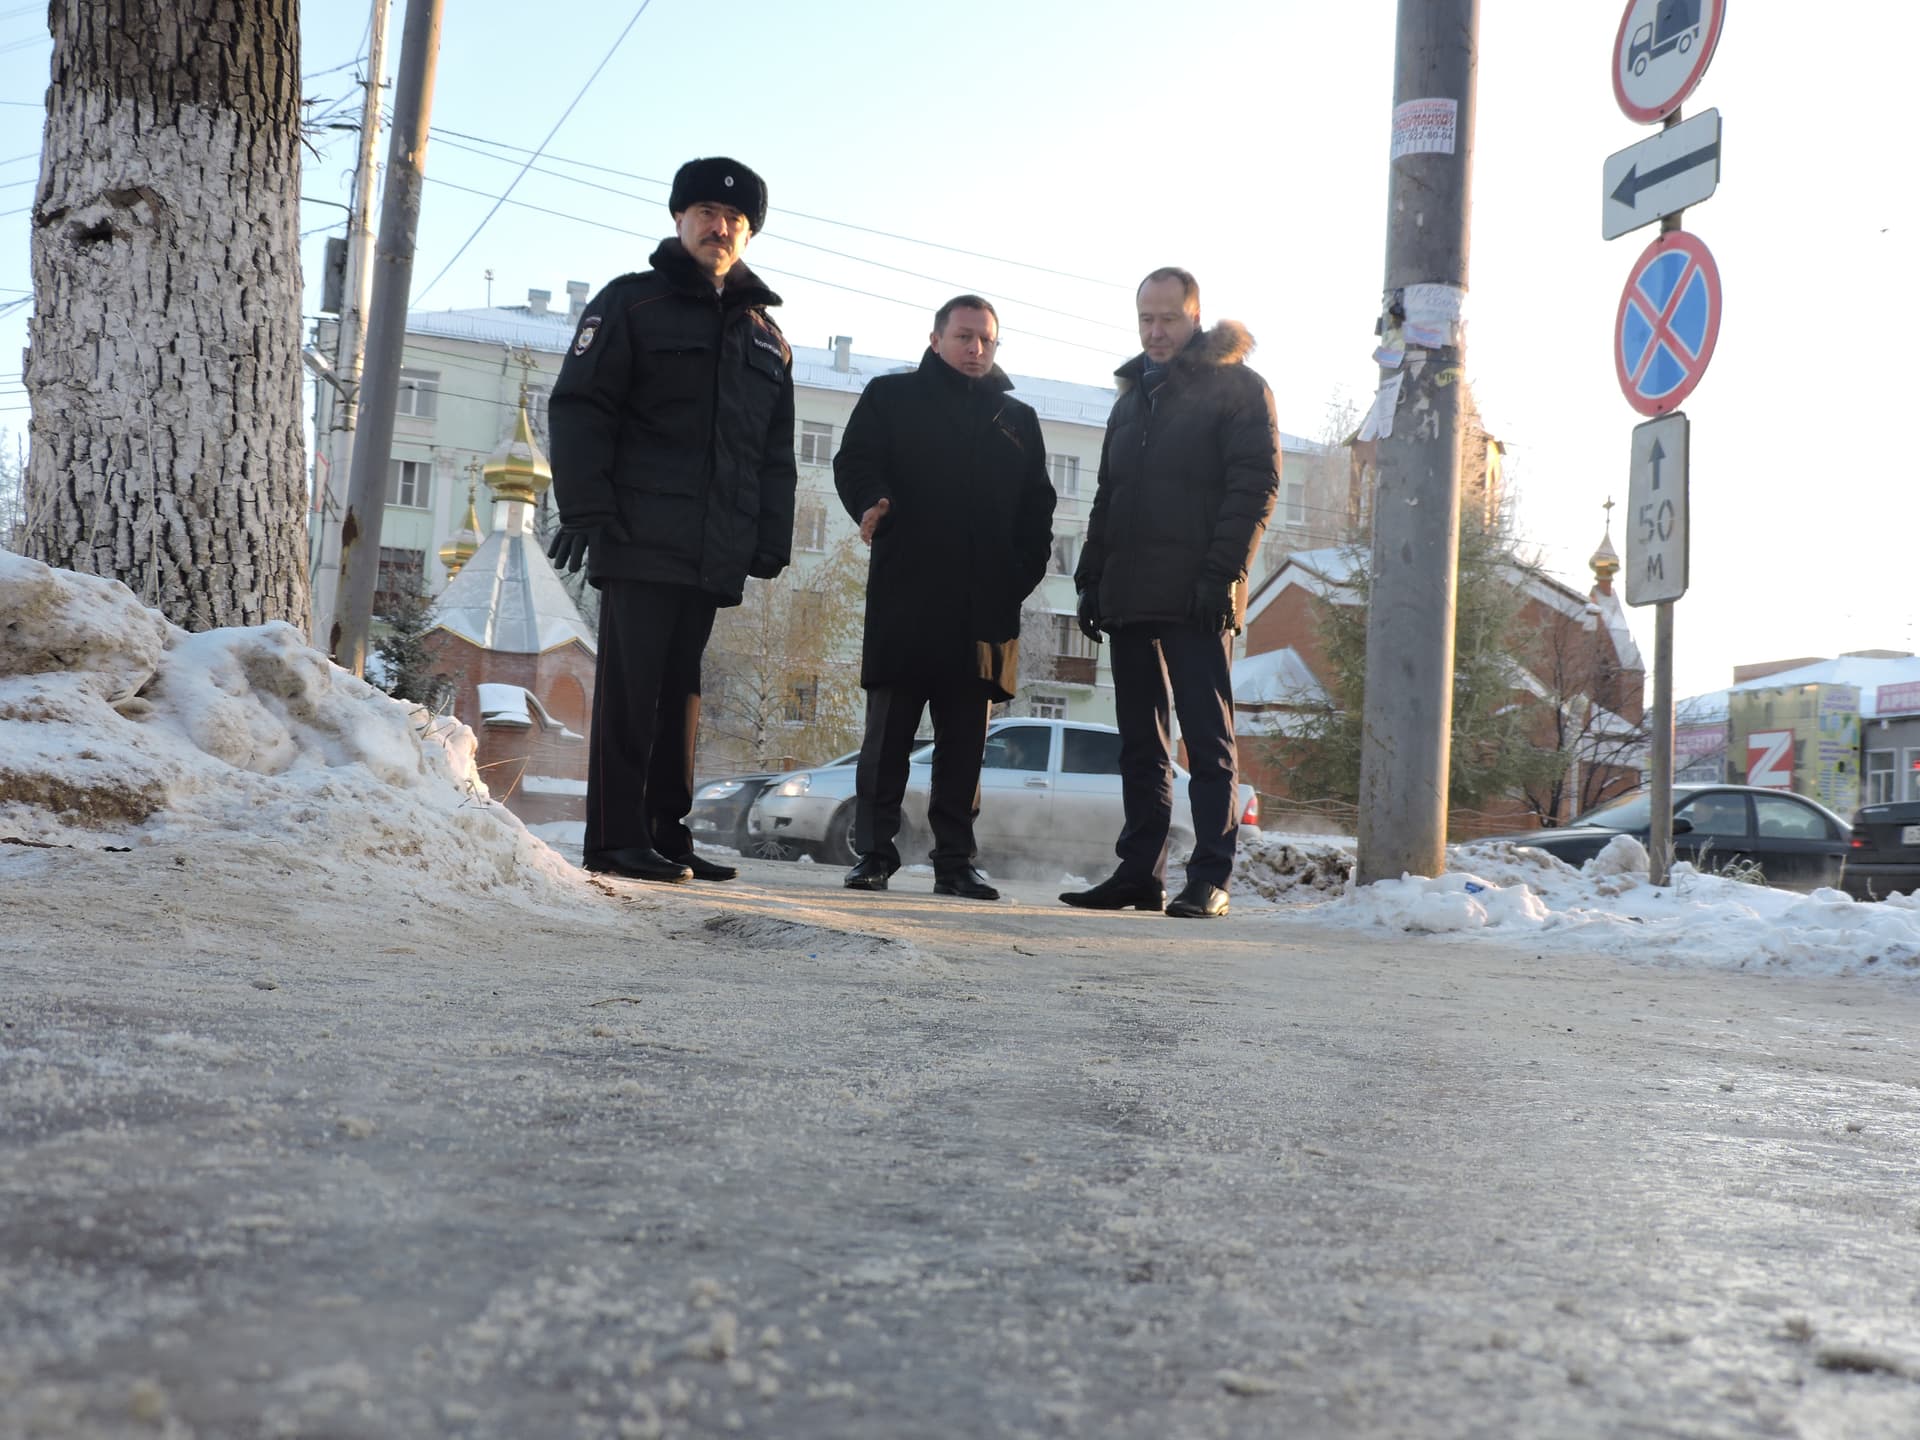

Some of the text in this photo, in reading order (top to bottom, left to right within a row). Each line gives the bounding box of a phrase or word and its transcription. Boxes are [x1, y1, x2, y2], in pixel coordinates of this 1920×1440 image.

[1638, 498, 1675, 545] 50
[1646, 553, 1664, 582] М
[1748, 731, 1792, 787] Z
